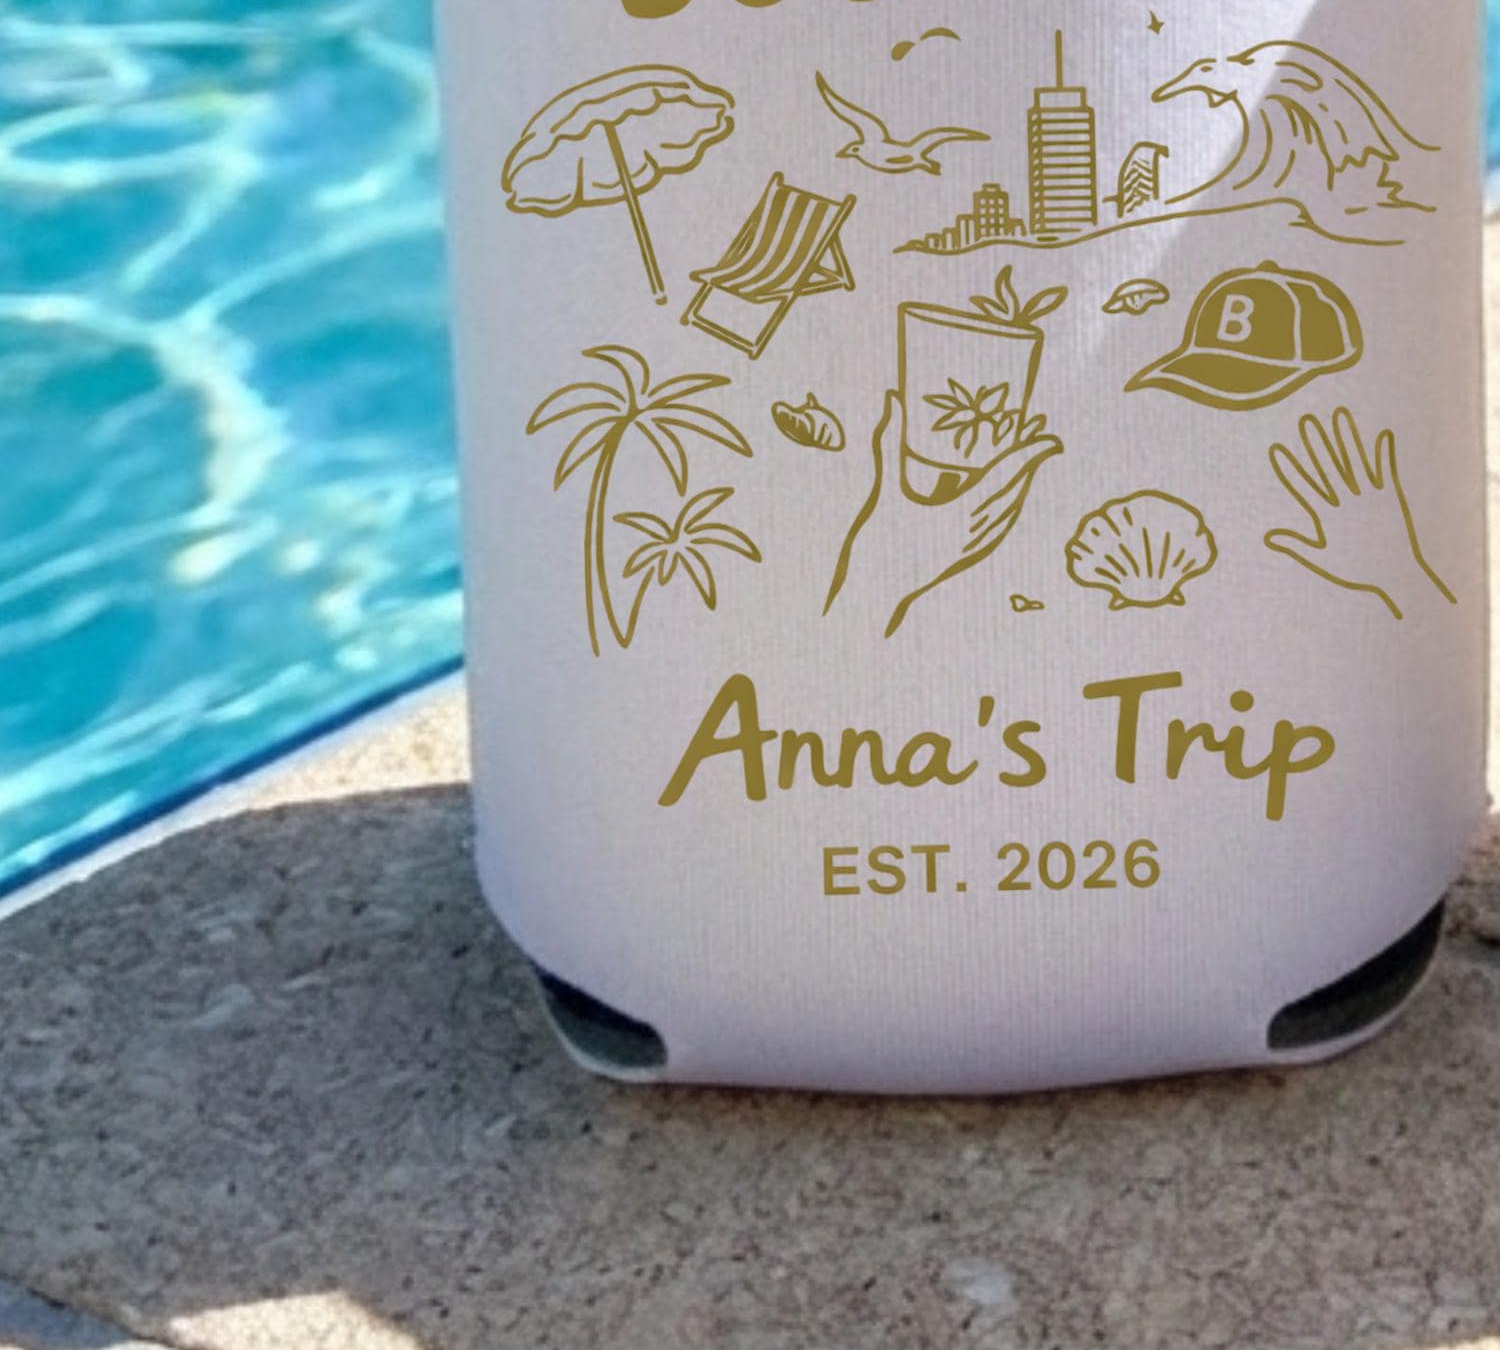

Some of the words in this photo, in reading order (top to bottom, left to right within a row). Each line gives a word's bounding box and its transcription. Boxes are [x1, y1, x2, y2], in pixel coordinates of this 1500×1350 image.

[1216, 294, 1254, 342] B
[658, 673, 1046, 807] Anna's
[1082, 671, 1336, 821] Trip
[823, 844, 966, 896] EST.
[998, 839, 1160, 891] 2026
